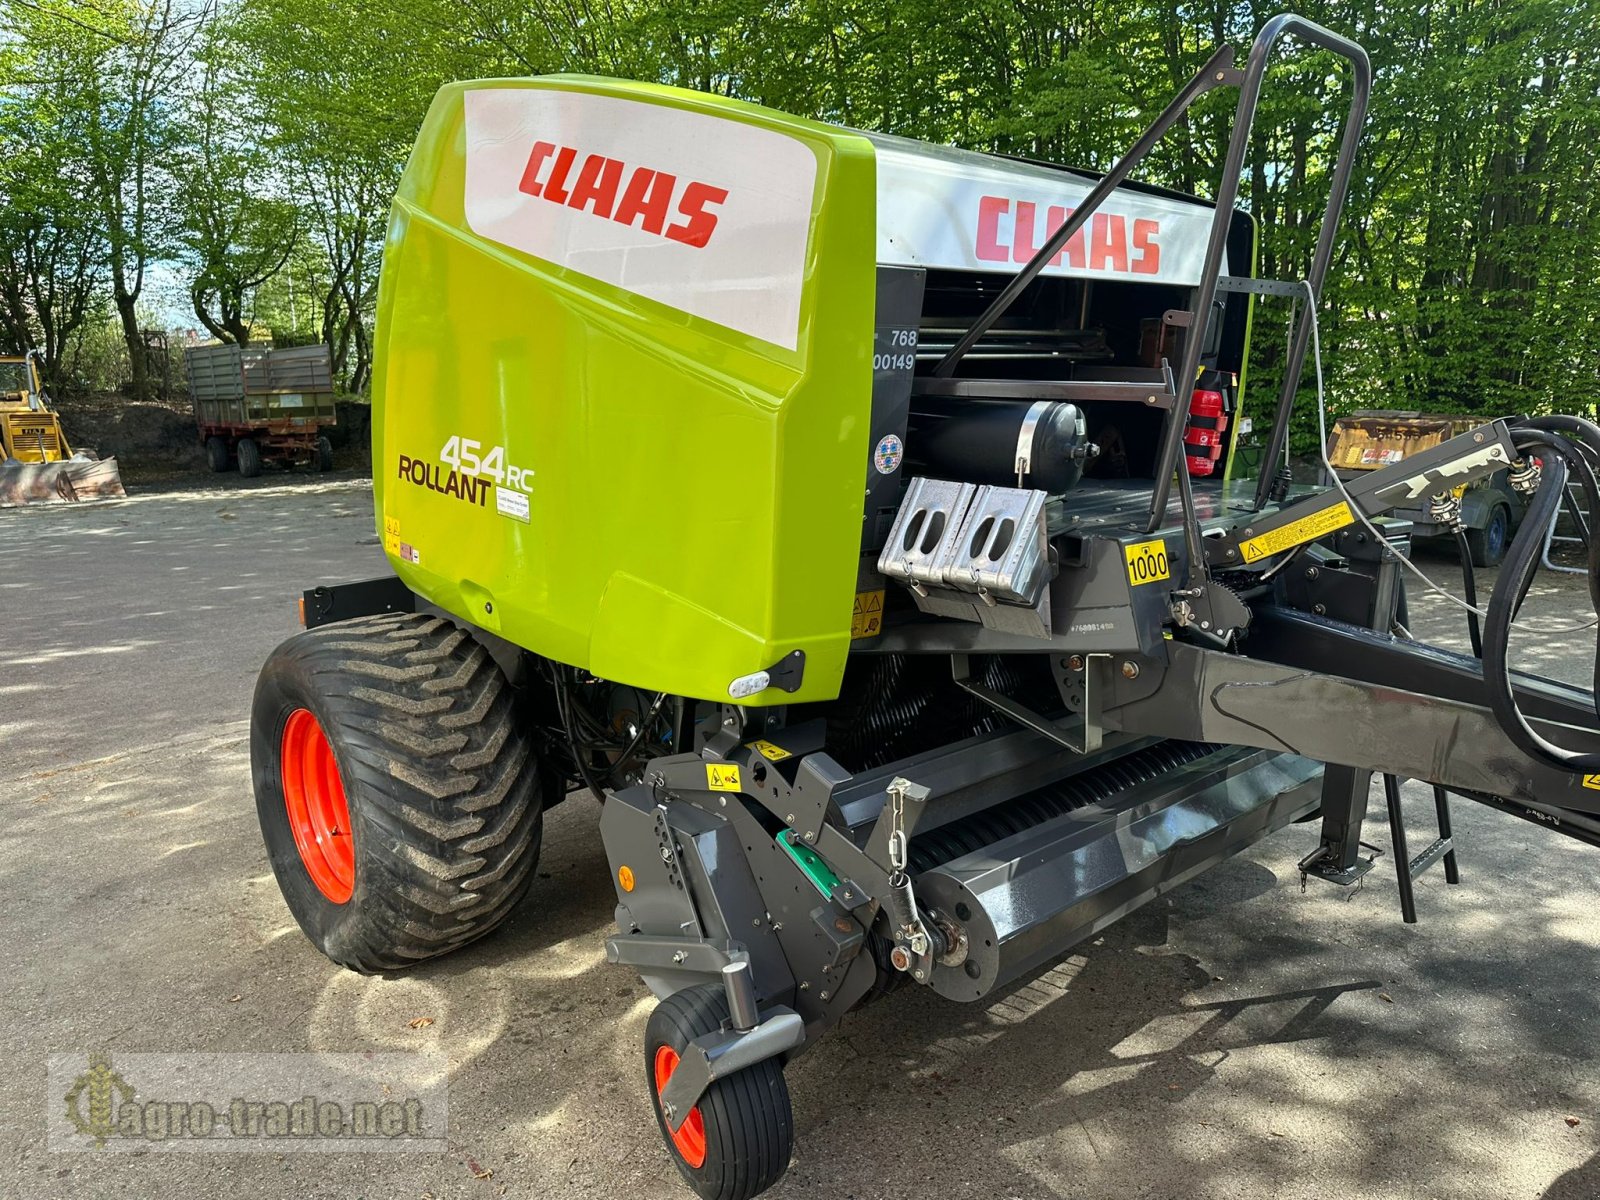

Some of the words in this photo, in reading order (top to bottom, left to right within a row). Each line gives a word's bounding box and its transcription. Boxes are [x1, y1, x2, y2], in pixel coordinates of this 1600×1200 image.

[518, 141, 729, 248] CLAAS
[976, 196, 1160, 275] CLAAS
[892, 330, 917, 346] 768
[398, 454, 492, 507] ROLLANT
[440, 435, 505, 484] 454
[507, 464, 534, 493] RC
[1129, 552, 1167, 581] 1000
